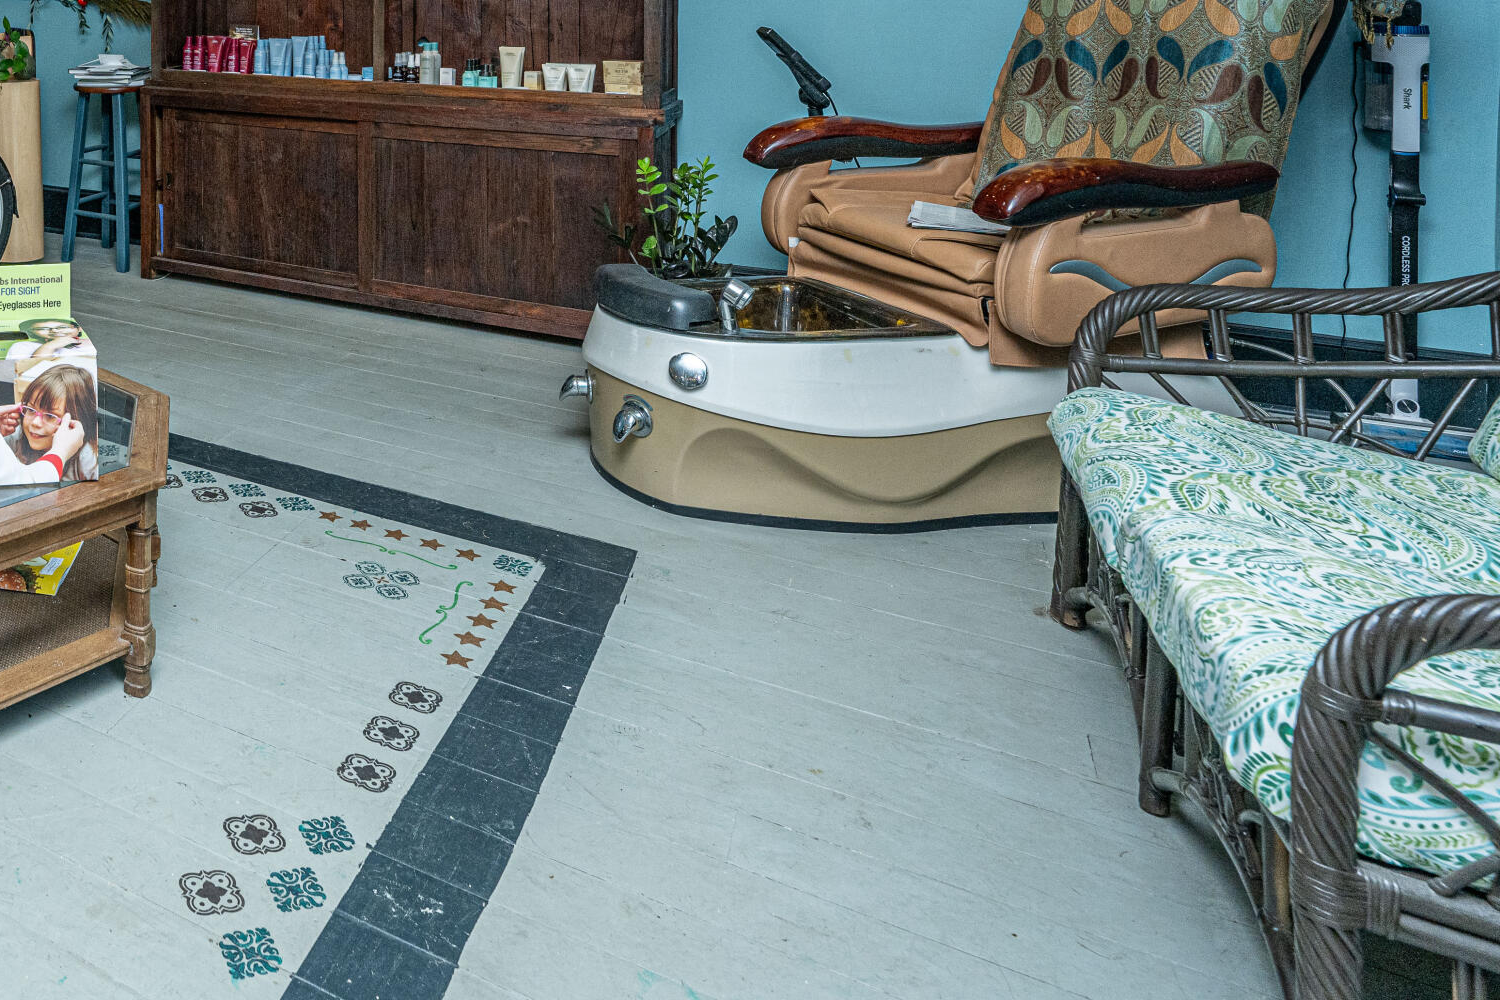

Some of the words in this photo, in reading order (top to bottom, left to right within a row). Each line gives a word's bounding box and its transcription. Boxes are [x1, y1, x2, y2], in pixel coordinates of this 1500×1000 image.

[1403, 88, 1412, 110] Shark
[1402, 236, 1411, 273] CORDLESS
[10, 275, 63, 285] International
[0, 287, 16, 296] FOR
[18, 286, 41, 295] SIGHT
[42, 299, 62, 308] Here
